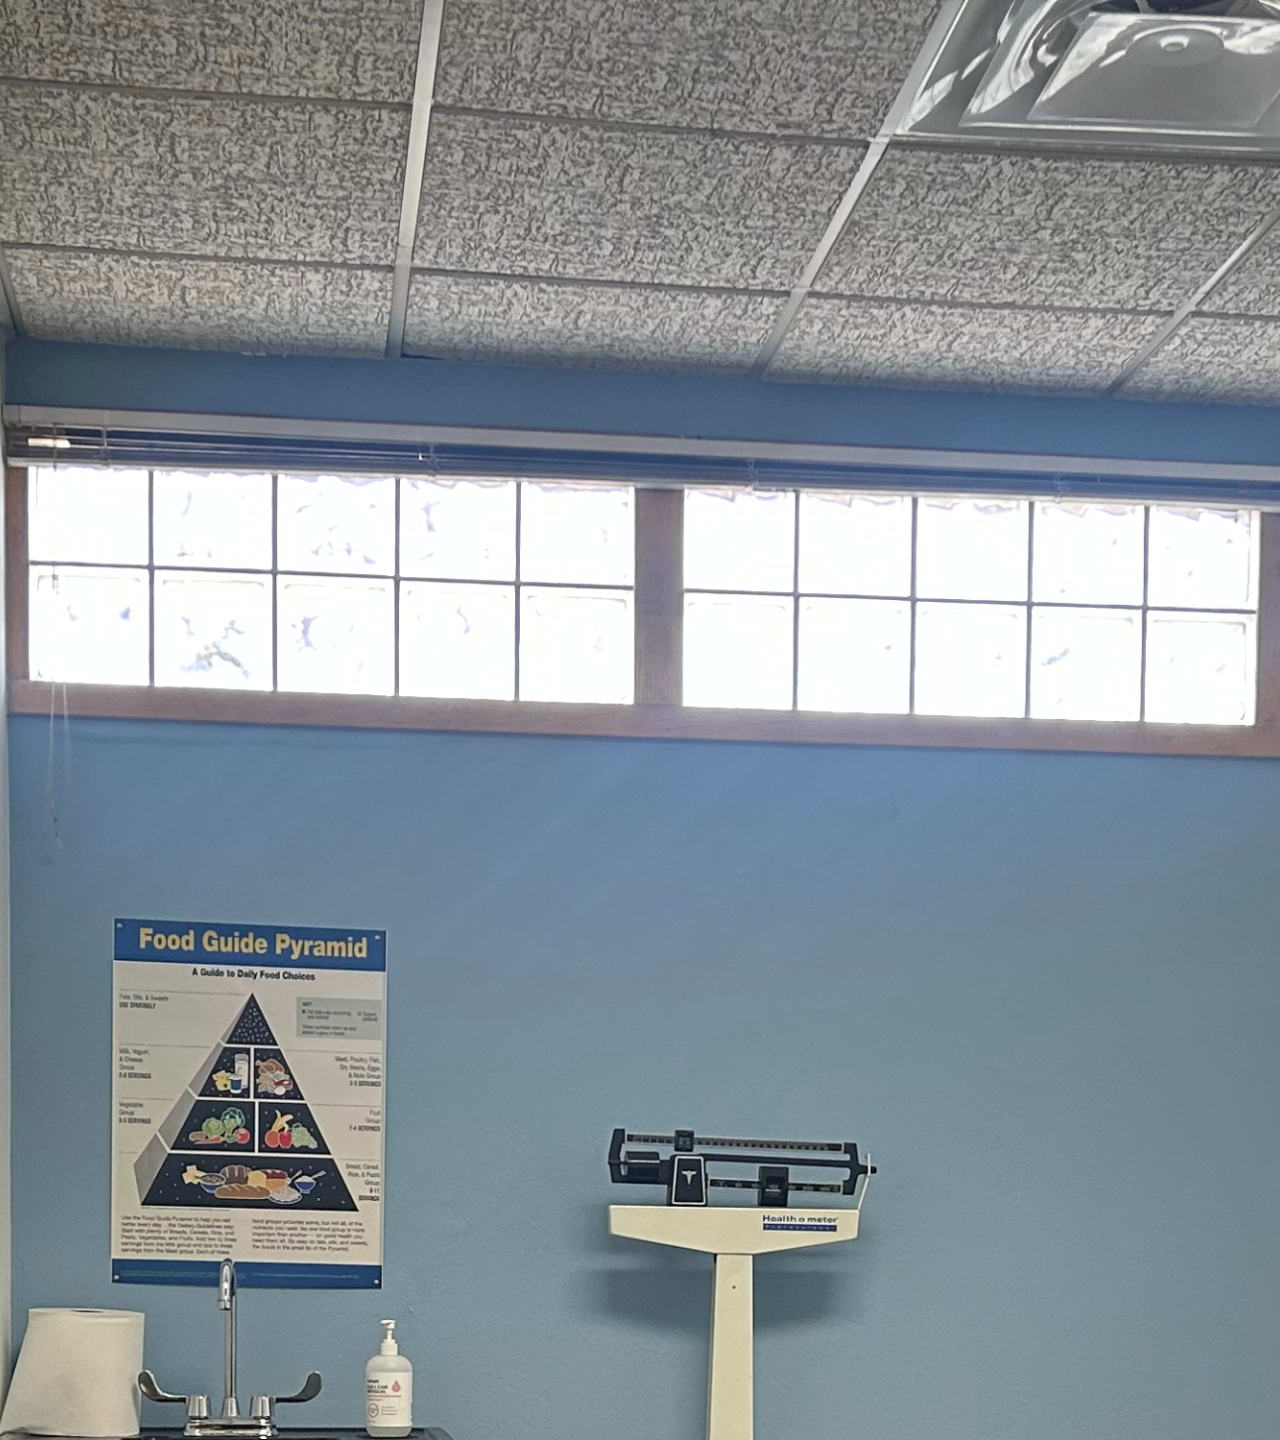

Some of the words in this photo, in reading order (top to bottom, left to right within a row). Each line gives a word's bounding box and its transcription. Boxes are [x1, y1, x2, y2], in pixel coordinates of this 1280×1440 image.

[139, 927, 195, 951] Food
[202, 930, 268, 954] Guide
[275, 933, 368, 960] Pyramid
[192, 968, 198, 976] A
[200, 968, 224, 977] Guide
[226, 969, 235, 978] to
[237, 969, 258, 980] Daily
[260, 970, 280, 979] Food
[282, 971, 316, 981] Choices
[762, 1214, 797, 1223] Health
[807, 1216, 837, 1224] meter
